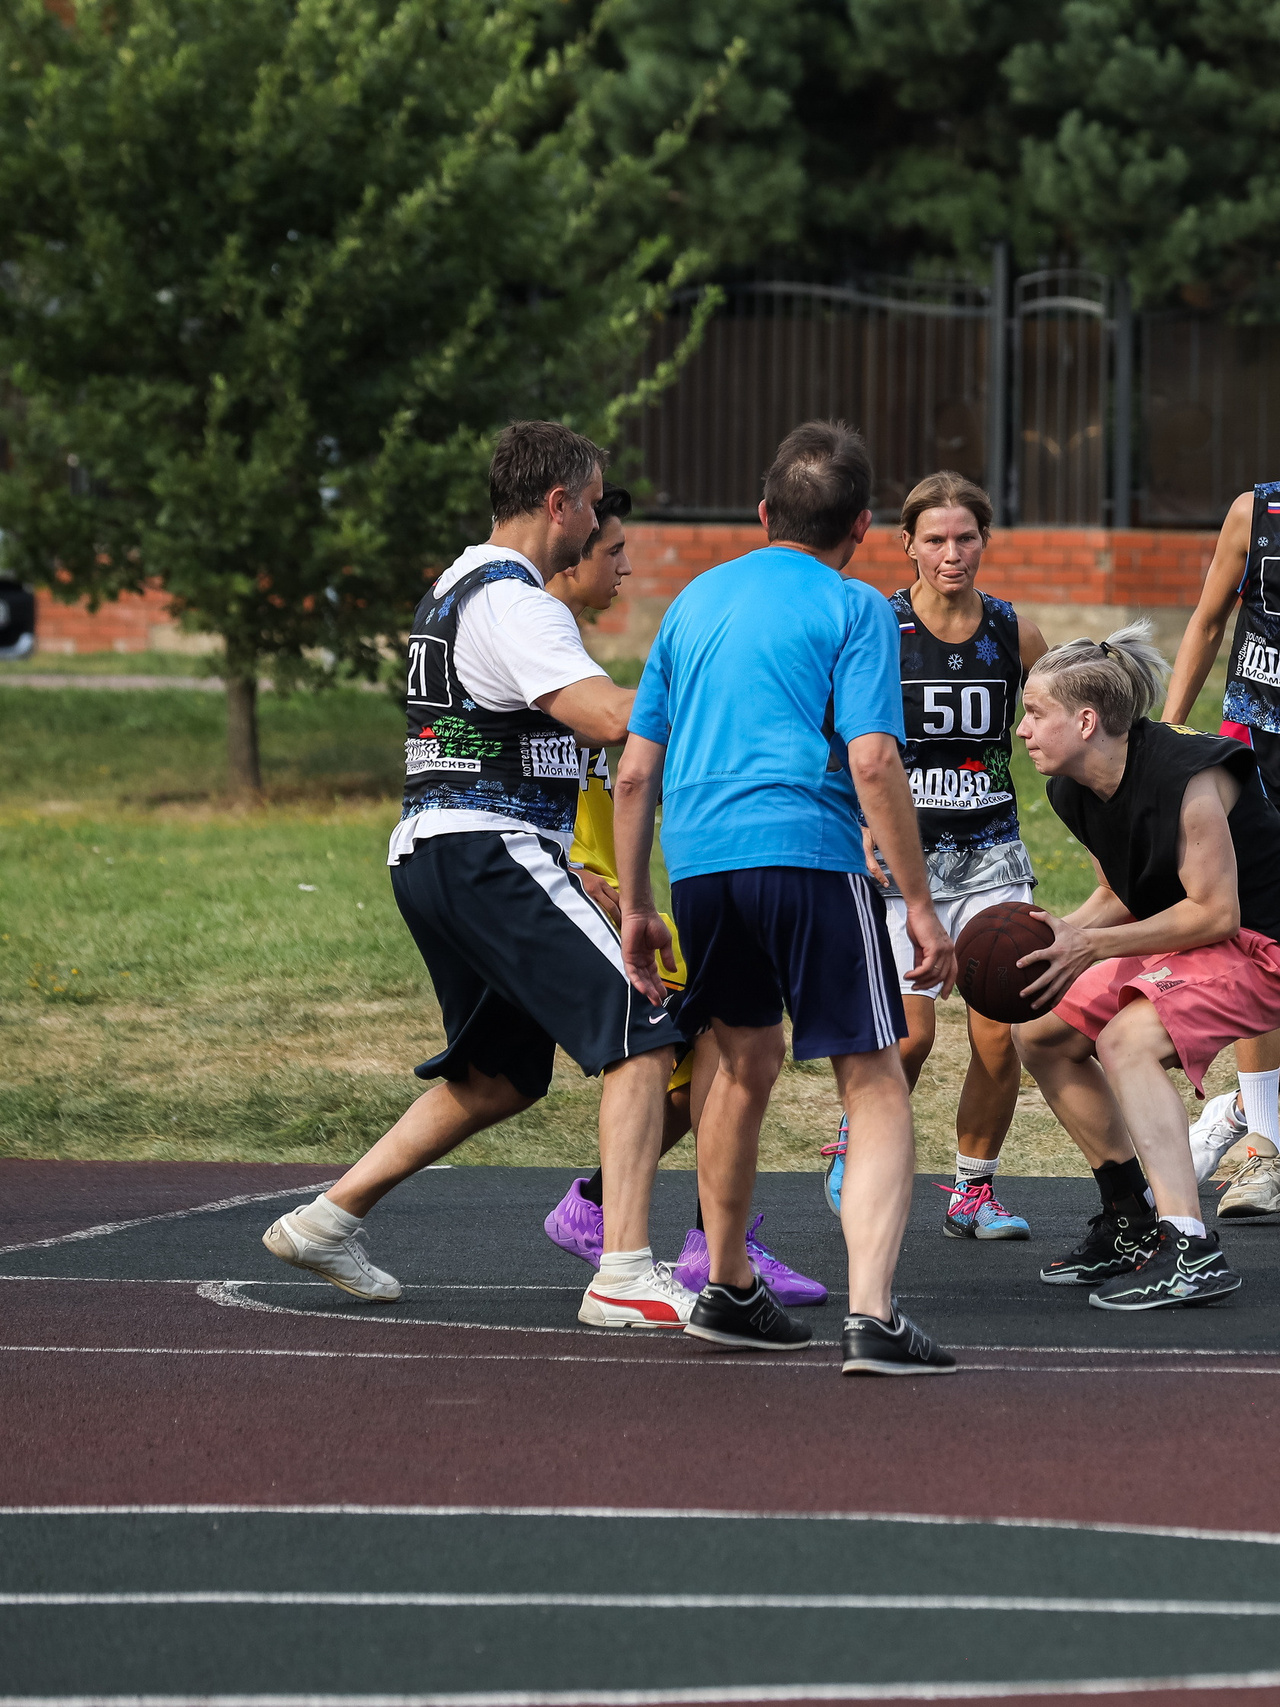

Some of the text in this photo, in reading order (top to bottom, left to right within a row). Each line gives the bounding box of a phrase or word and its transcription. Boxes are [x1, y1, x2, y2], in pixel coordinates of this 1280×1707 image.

[407, 641, 428, 697] 21
[923, 685, 991, 735] 50
[538, 764, 563, 776] Моя
[905, 767, 991, 799] АПОВО
